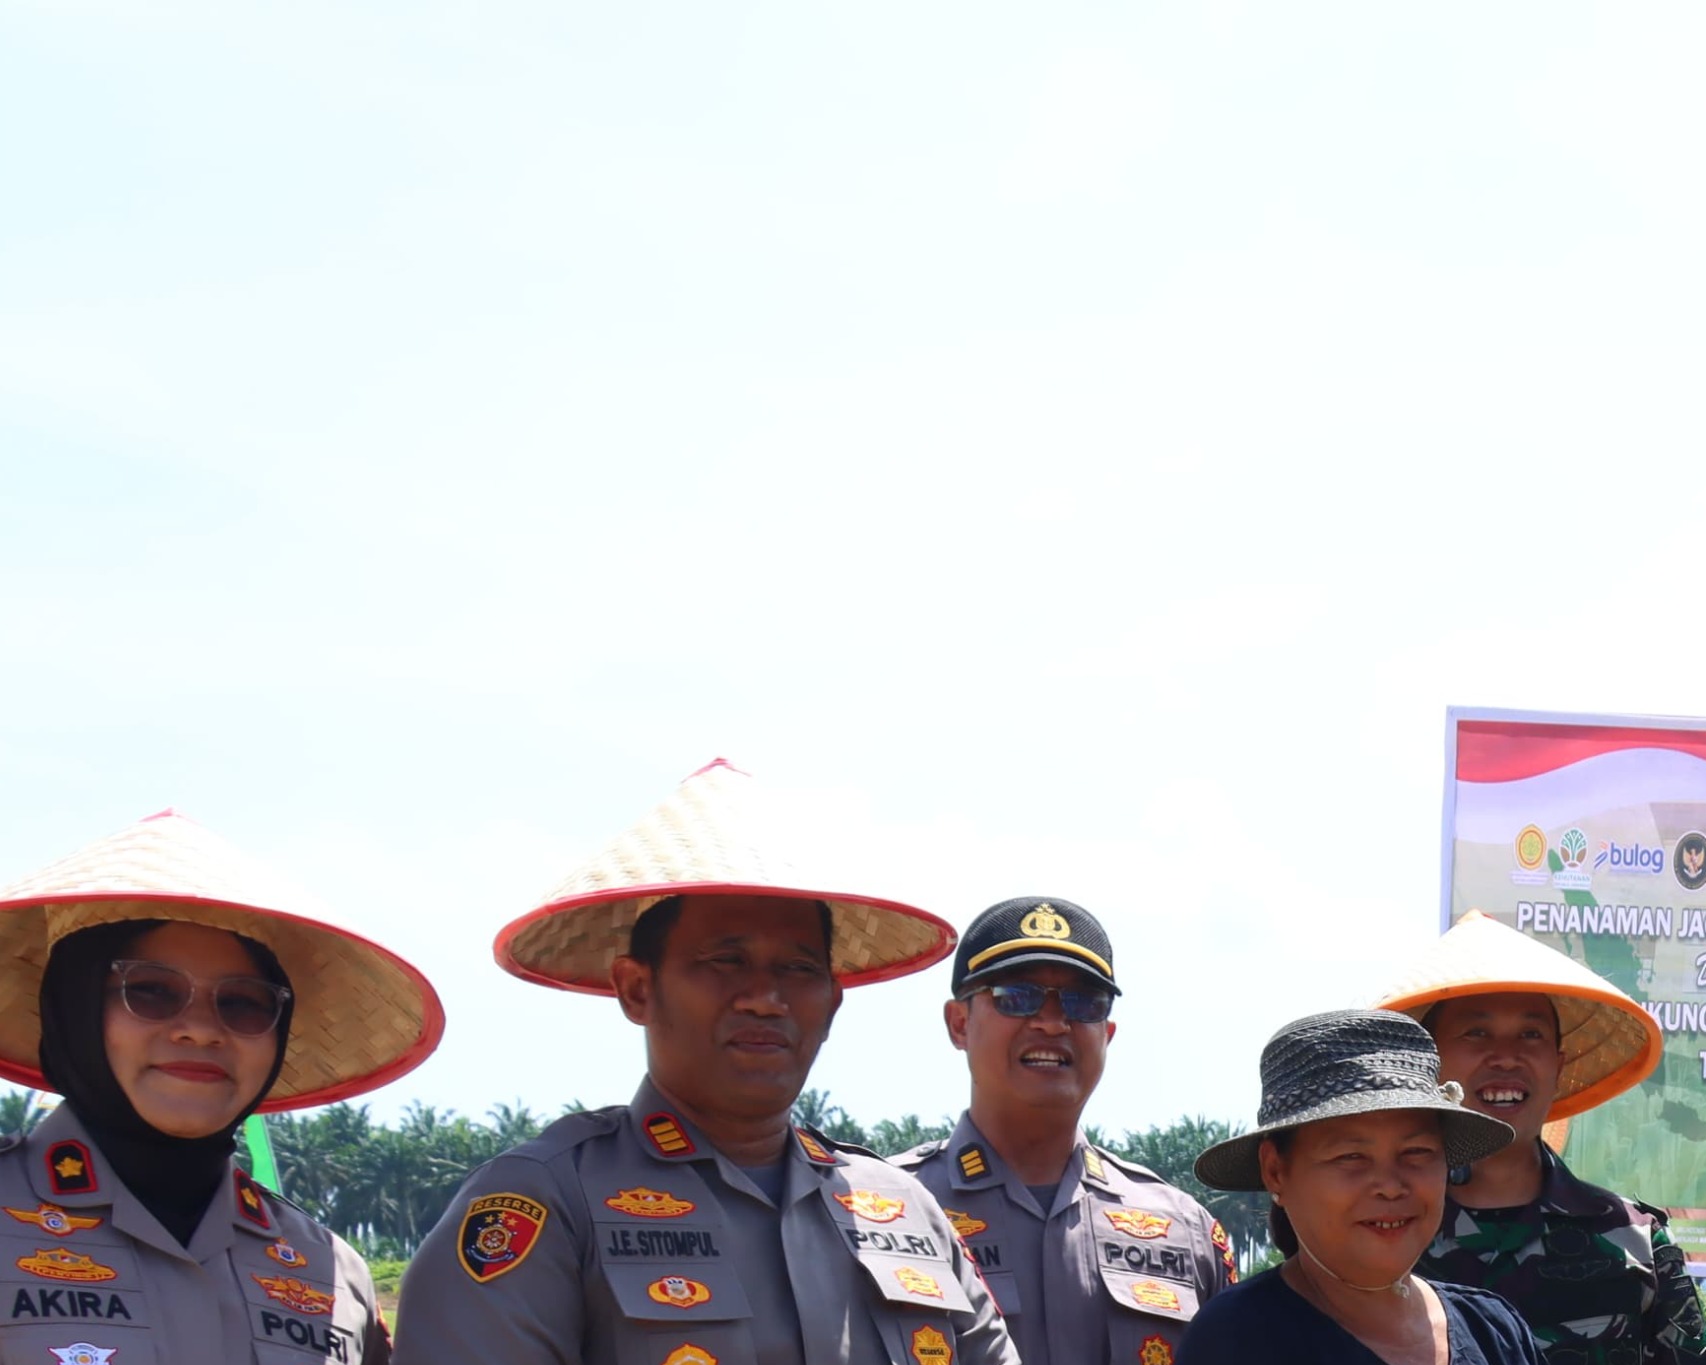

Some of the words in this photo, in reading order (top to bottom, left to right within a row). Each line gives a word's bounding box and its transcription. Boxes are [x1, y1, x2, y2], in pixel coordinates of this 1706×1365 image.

[1610, 842, 1664, 873] bulog
[1516, 901, 1673, 936] PENANAMAN
[473, 1198, 541, 1219] RESERSE
[846, 1228, 939, 1257] POLRI
[1104, 1242, 1186, 1274] POLRI
[12, 1288, 132, 1320] AKIRA
[261, 1311, 349, 1365] POLRI
